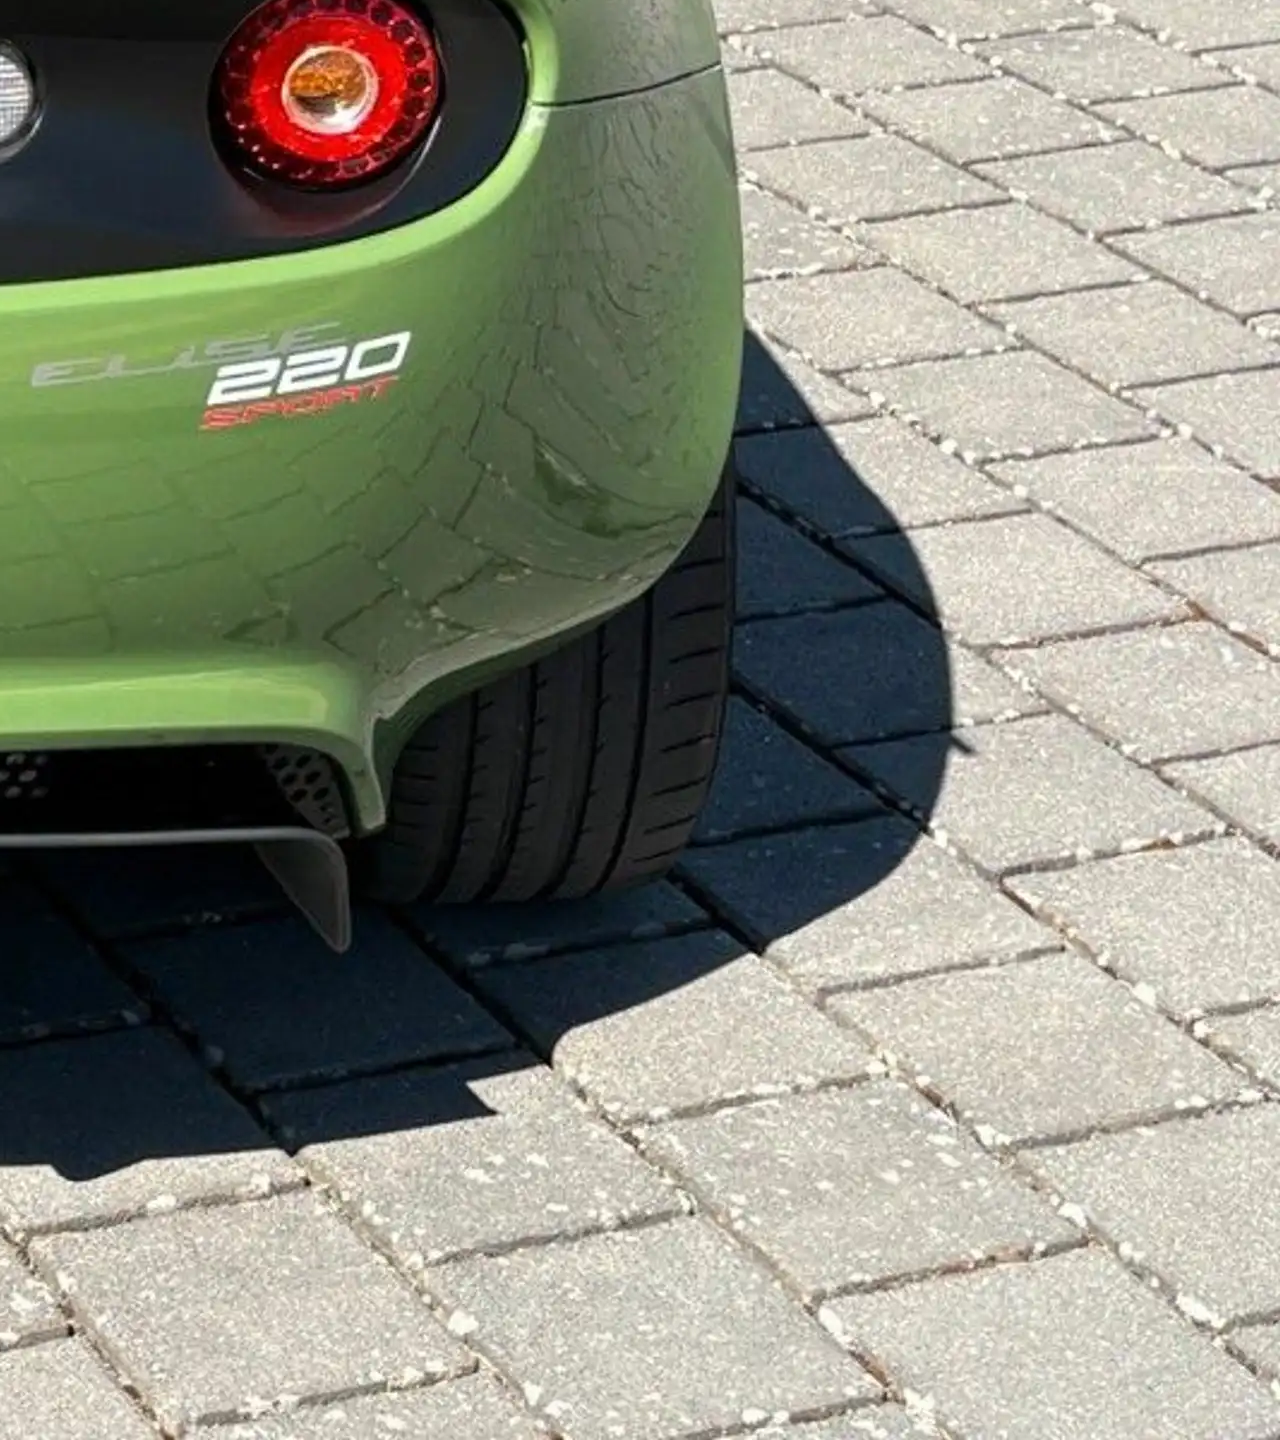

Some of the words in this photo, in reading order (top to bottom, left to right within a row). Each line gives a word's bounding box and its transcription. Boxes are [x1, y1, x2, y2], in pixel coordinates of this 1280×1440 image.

[31, 321, 345, 388] ELISE
[206, 331, 412, 407] 220
[199, 375, 400, 431] SPORT
